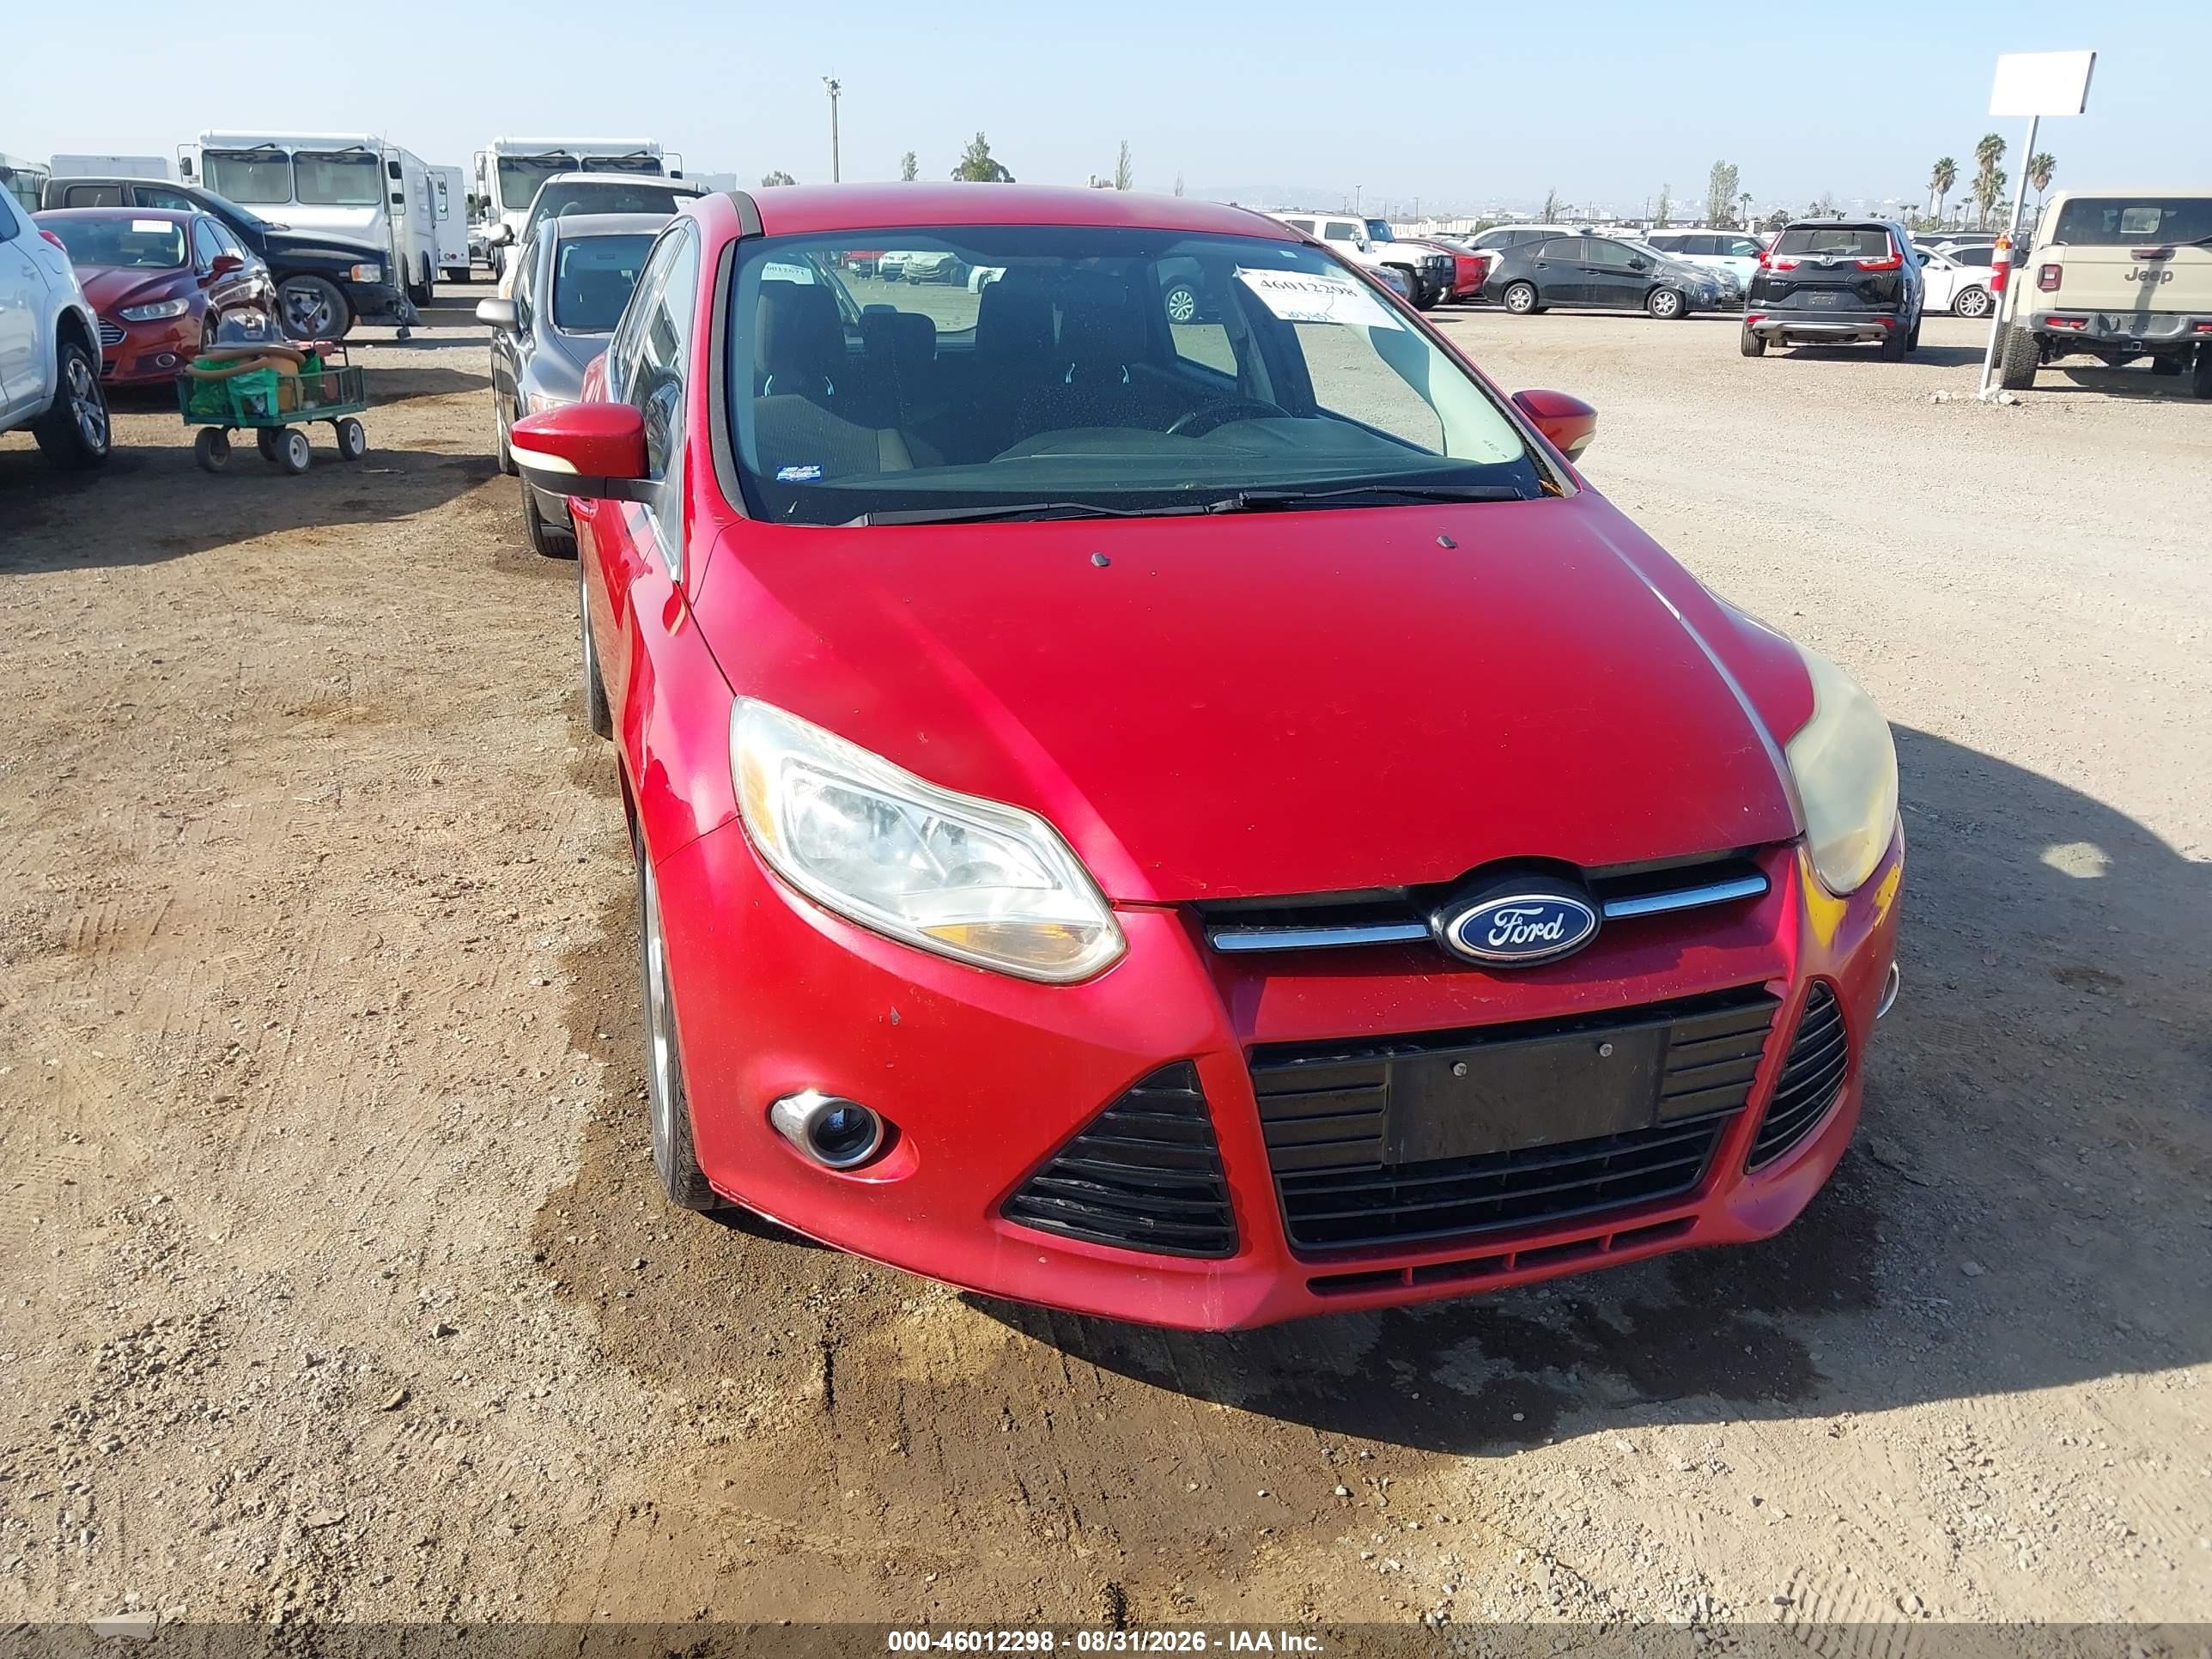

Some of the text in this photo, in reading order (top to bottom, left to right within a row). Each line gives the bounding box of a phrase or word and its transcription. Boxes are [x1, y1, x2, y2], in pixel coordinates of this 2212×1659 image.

[2124, 267, 2174, 285] Jeep
[1260, 279, 1358, 298] 46012298
[1488, 907, 1565, 946] Ford
